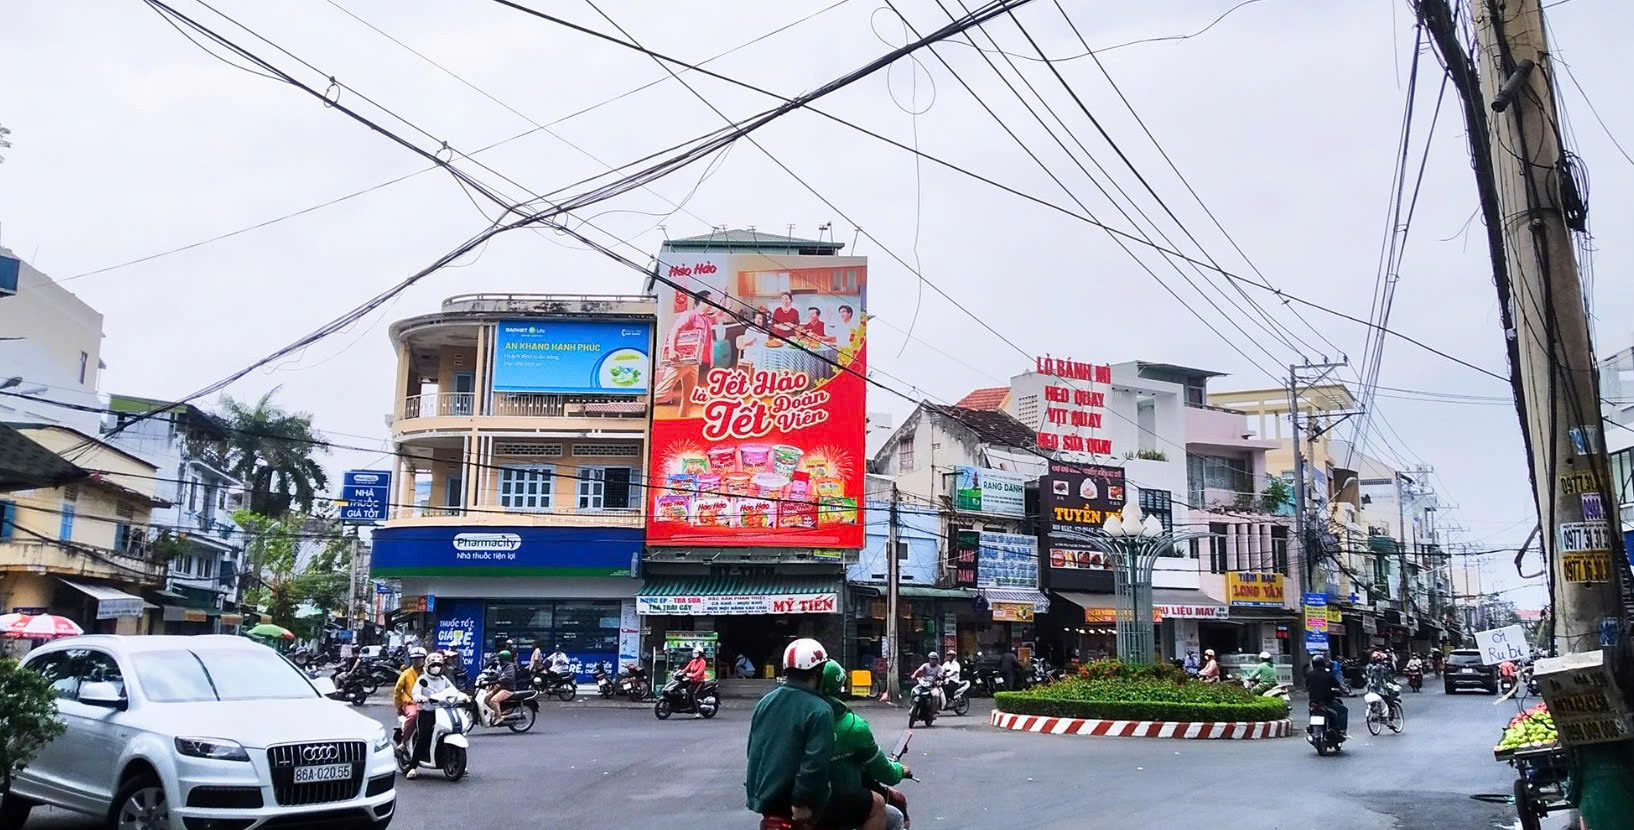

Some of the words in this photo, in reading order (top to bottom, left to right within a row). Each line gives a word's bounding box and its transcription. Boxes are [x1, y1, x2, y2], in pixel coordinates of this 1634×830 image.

[694, 261, 717, 275] Hảo
[505, 342, 518, 350] AN
[519, 343, 550, 351] KHANG
[1036, 353, 1053, 375] LÒ
[1057, 356, 1092, 381] BÁNH
[708, 369, 750, 396] Tết
[753, 370, 807, 395] Hảo
[691, 388, 708, 401] là
[1045, 385, 1069, 403] HEO
[1075, 389, 1104, 407] QUAY
[704, 400, 772, 438] Tết
[773, 390, 827, 413] Đoàn
[776, 409, 826, 431] Viên
[1047, 408, 1068, 427] VỊT
[1071, 411, 1102, 429] QUAY
[1037, 432, 1059, 450] HEO
[1087, 438, 1112, 455] QUAY
[355, 487, 375, 497] NHÀ
[1004, 482, 1024, 494] DANH
[346, 508, 362, 518] GIÁ
[363, 507, 380, 518] TỐT
[457, 535, 517, 549] Pharmacity
[456, 552, 472, 560] Nhà
[472, 552, 492, 560] thuốc
[493, 552, 507, 560] tiện
[507, 552, 516, 560] lợi
[1239, 572, 1257, 584] TIỆM
[1261, 573, 1276, 585] BẠC
[1232, 585, 1260, 598] LONG
[774, 597, 793, 612] MỸ
[799, 595, 834, 611] TIẾN
[1172, 605, 1193, 618] LIỆU
[1195, 607, 1216, 616] MAY
[440, 617, 460, 628] THUỐC
[461, 617, 475, 628] TỐT,
[438, 628, 454, 641] GIÁ
[295, 765, 350, 781] 86A-020.55
